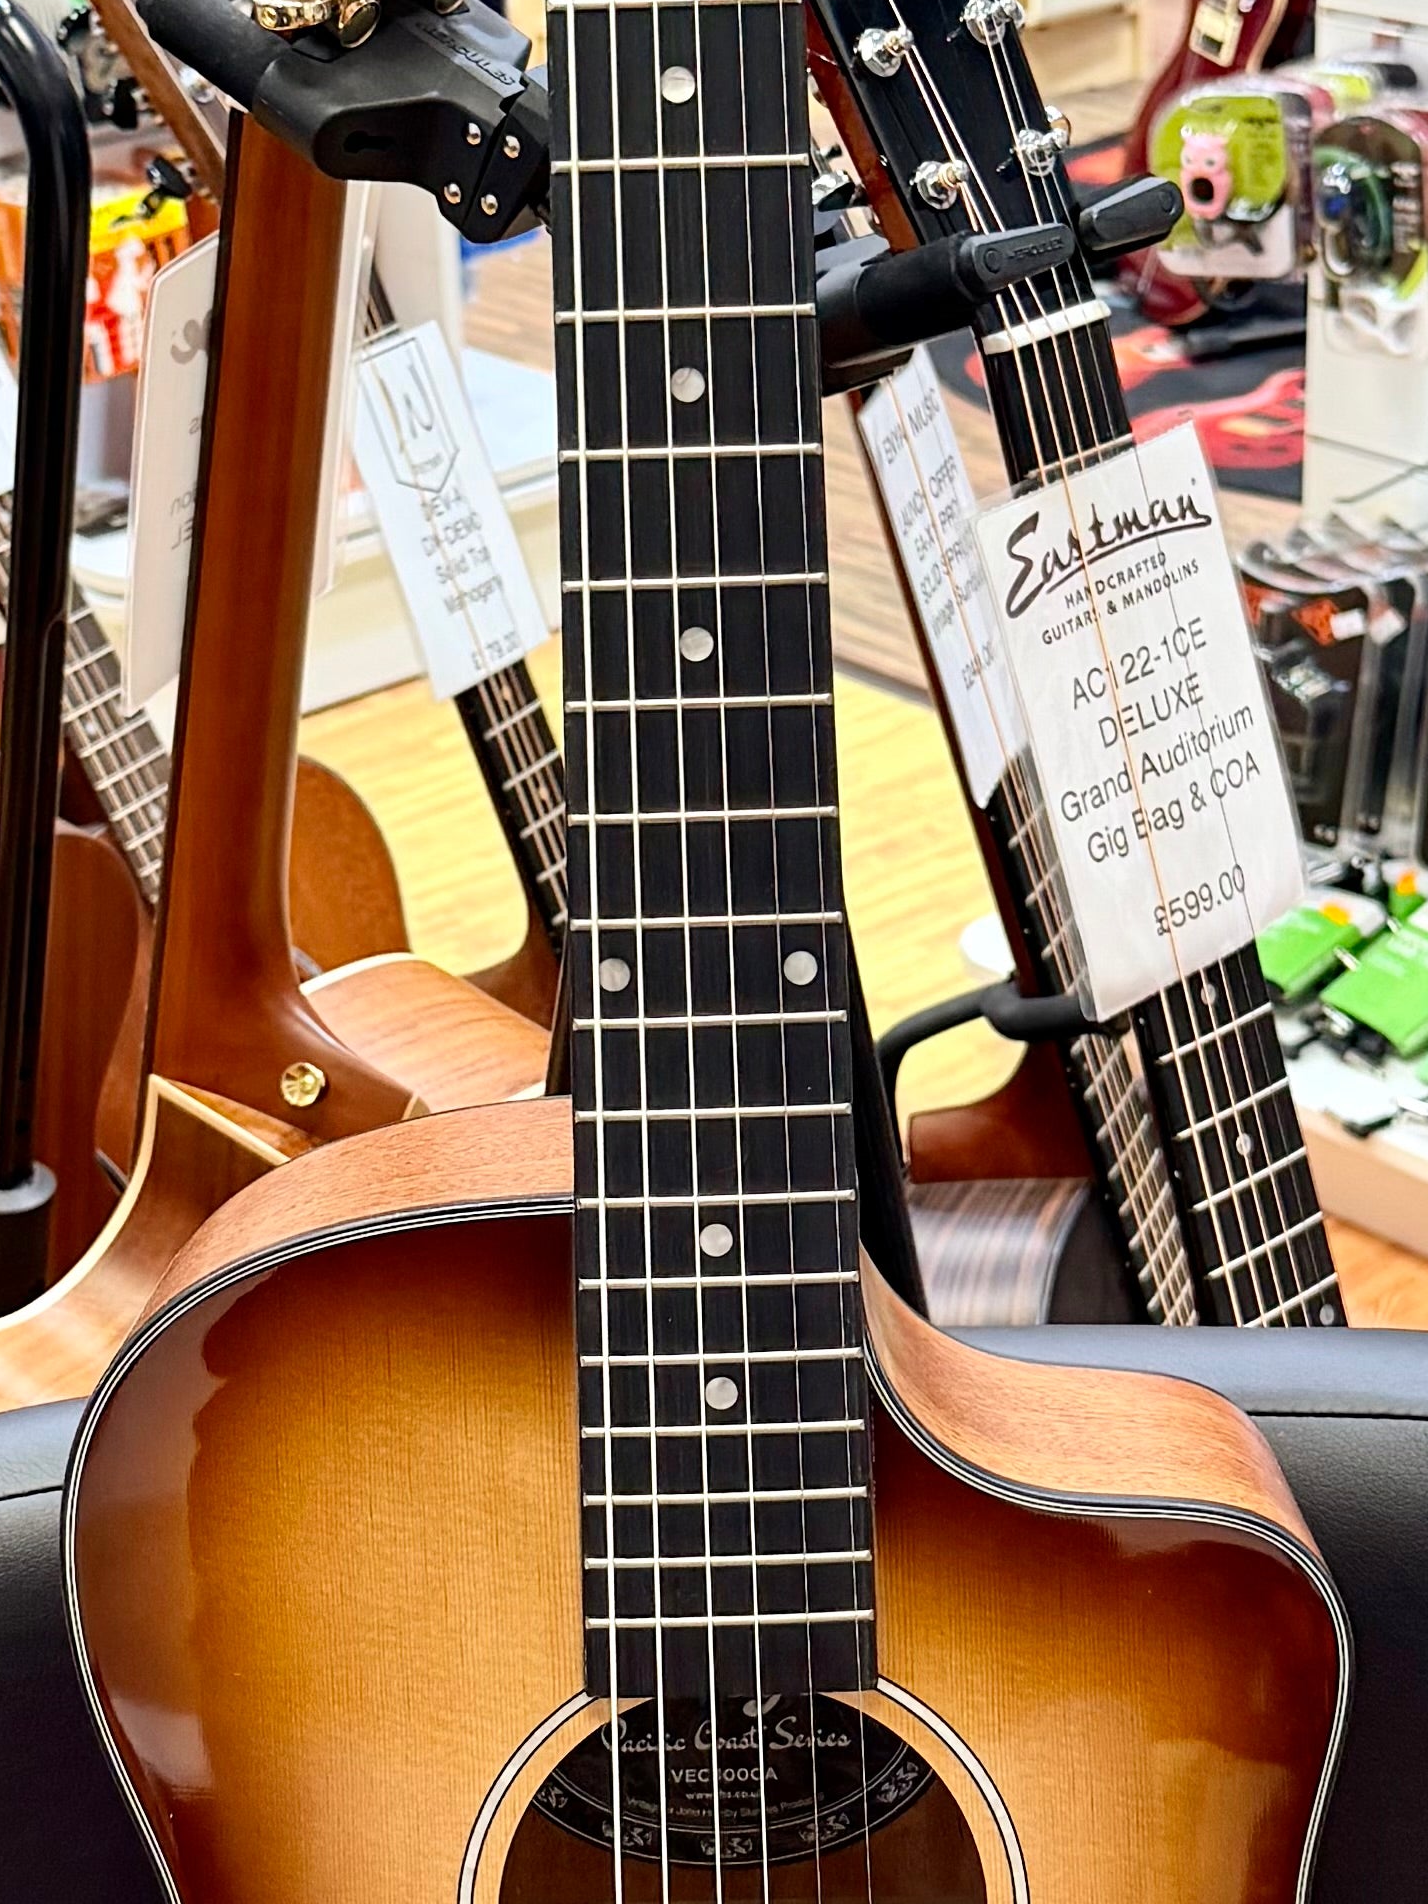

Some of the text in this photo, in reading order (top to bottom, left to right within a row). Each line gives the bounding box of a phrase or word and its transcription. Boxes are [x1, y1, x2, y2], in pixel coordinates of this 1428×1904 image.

[1005, 494, 1212, 619] Eastman
[1064, 551, 1166, 609] HANDCRAFTED
[1041, 558, 1199, 645] GUITARS & MANDOLINS
[1072, 617, 1207, 710] AC122-1CE
[1097, 672, 1204, 748] DELUXE
[1060, 705, 1255, 823] Grand Auditorium
[1087, 749, 1261, 863] Gig Bag & COA
[1153, 863, 1246, 937] £599.00
[601, 1717, 686, 1753] Paciic
[769, 1716, 852, 1750] Series
